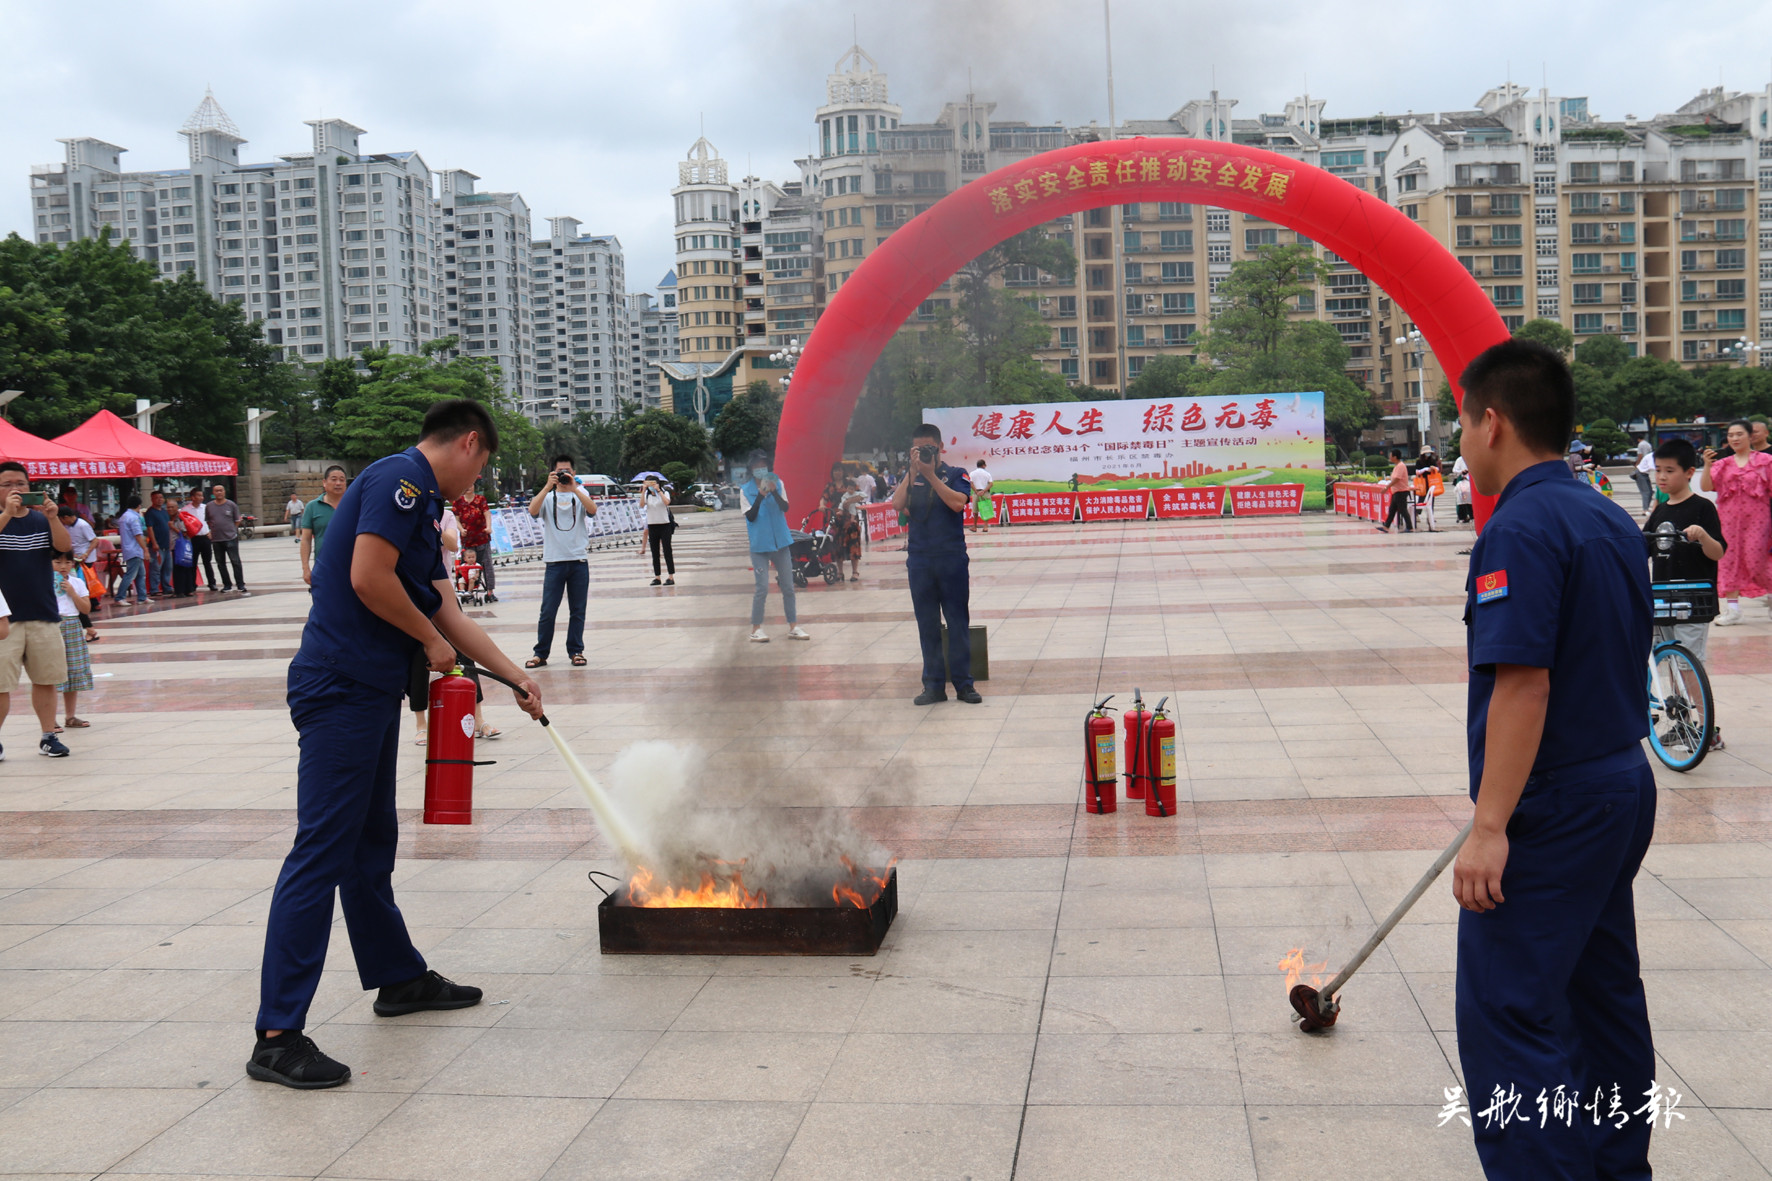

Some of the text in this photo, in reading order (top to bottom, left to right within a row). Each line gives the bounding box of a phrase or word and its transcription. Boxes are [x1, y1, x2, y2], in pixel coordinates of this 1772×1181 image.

[988, 155, 1290, 214] 落实安全责任推动安全发展
[971, 398, 1278, 440] 健康人生 绿色无毒
[1236, 489, 1297, 499] 健康人生 绿色无毒
[1085, 495, 1143, 505] 大力消除毒品危害
[1236, 499, 1297, 509] 拒绝毒品 珍爱生命
[1085, 504, 1143, 514] 保护人民身心健康
[1162, 501, 1216, 511] 共筑禁毒长城
[1012, 507, 1041, 516] 远离毒品
